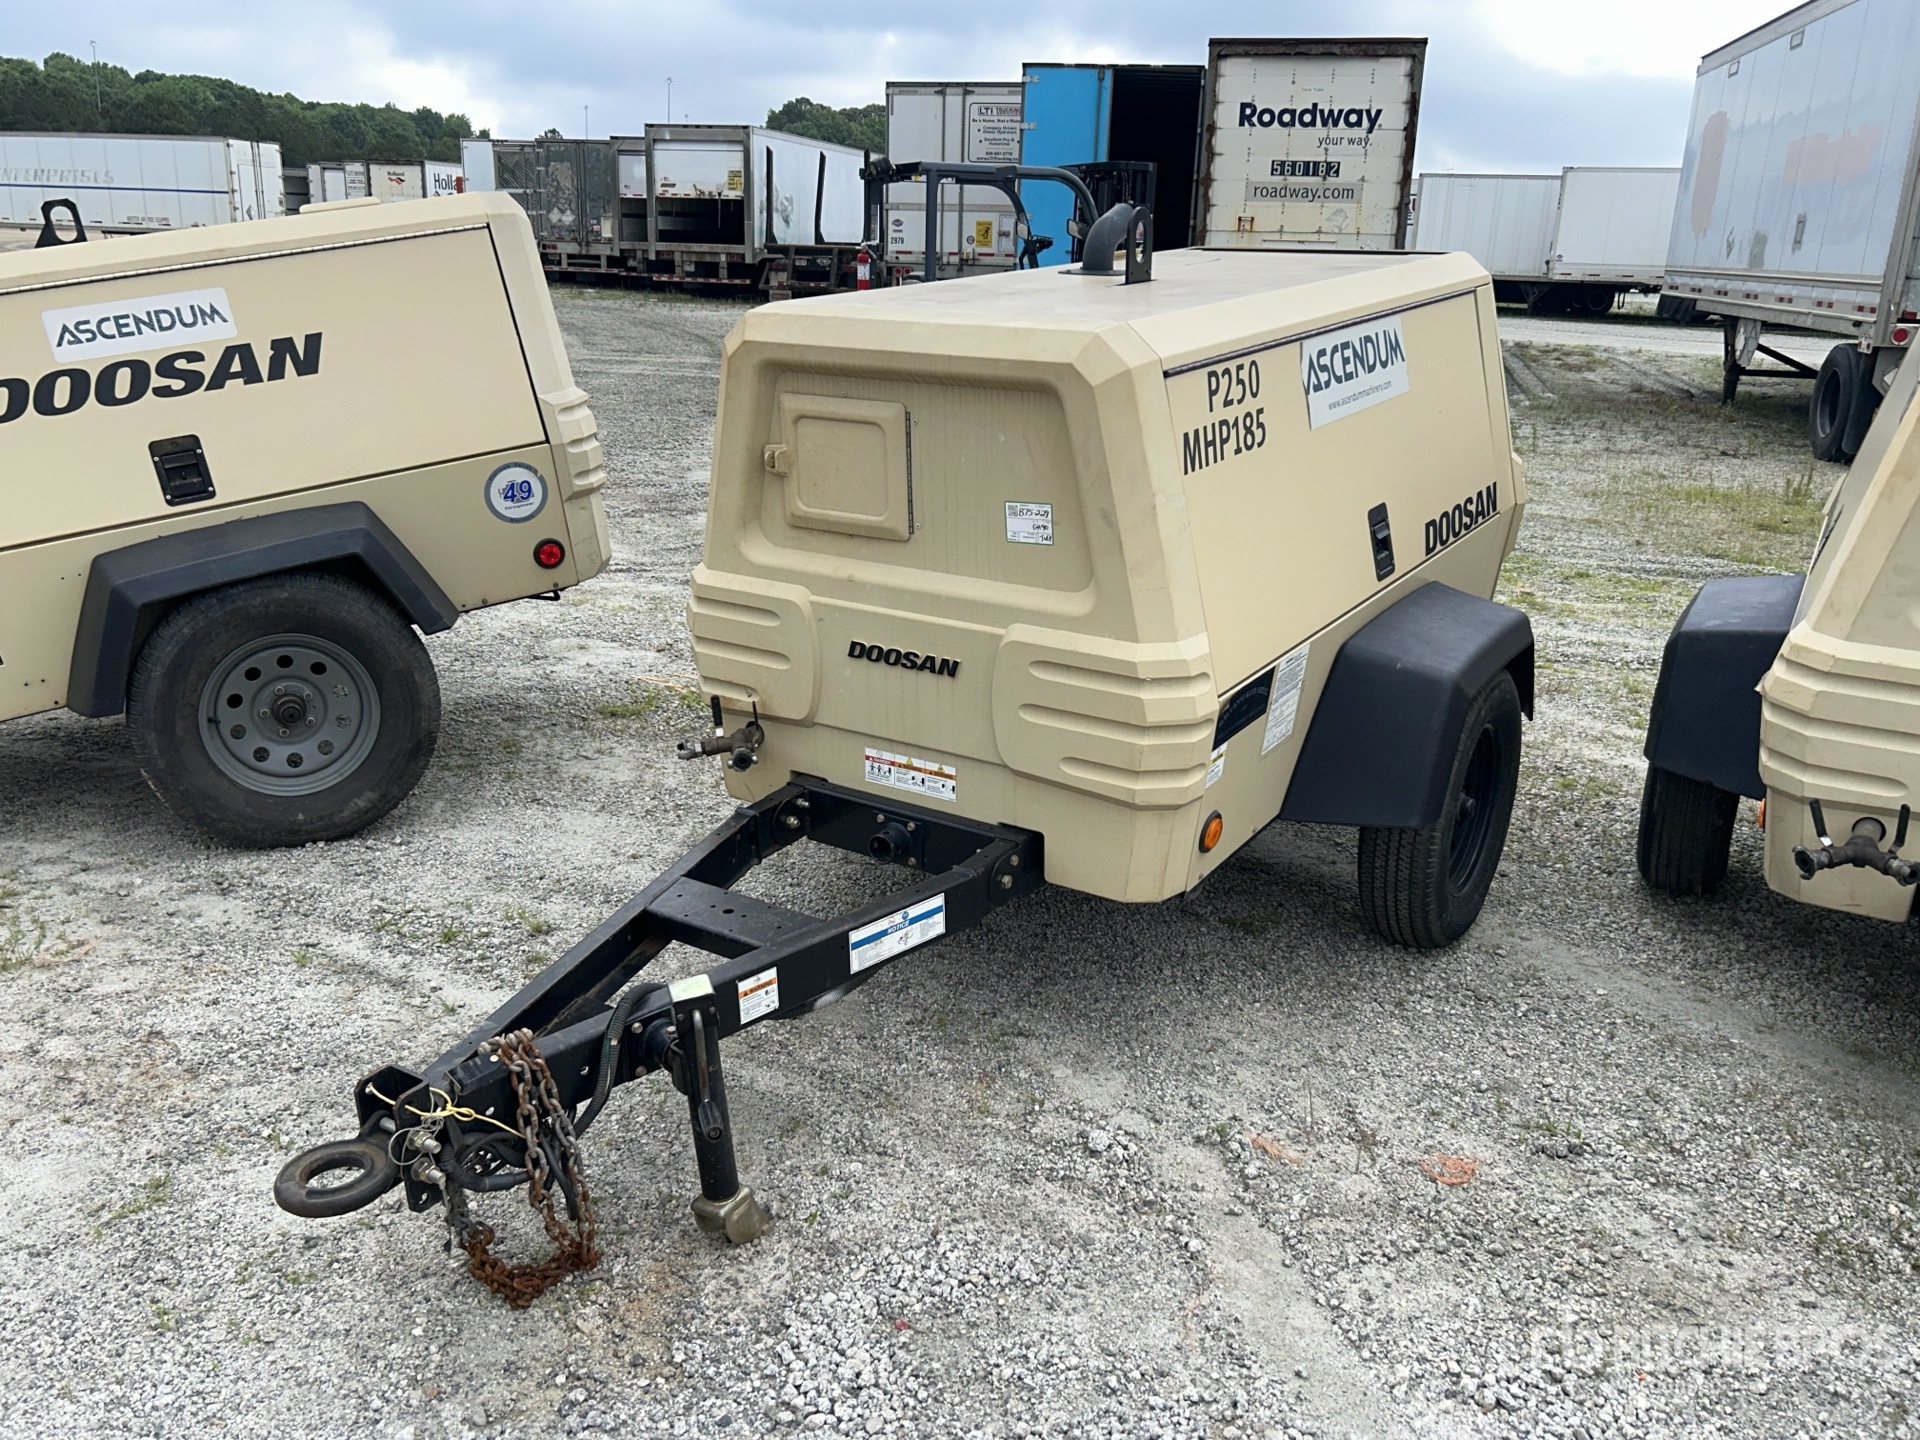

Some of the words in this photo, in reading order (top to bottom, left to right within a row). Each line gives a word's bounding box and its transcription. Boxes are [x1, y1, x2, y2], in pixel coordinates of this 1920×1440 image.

[979, 107, 993, 115] LTI
[1238, 102, 1383, 134] Roadway
[1316, 136, 1345, 148] your
[1347, 136, 1373, 149] way.
[0, 168, 115, 185] NTERPRISES
[1272, 161, 1339, 177] 560182
[1253, 185, 1354, 202] roadway.com
[890, 236, 905, 245] 2879
[55, 302, 230, 348] ASCENDUM
[1303, 327, 1405, 395] ASCENDUM
[1207, 359, 1260, 413] P250
[1183, 406, 1267, 476] MHP185
[503, 480, 532, 503] 49
[1425, 481, 1497, 557] DOOSAN
[847, 640, 961, 677] DOOSAN
[887, 919, 910, 934] NOTICE
